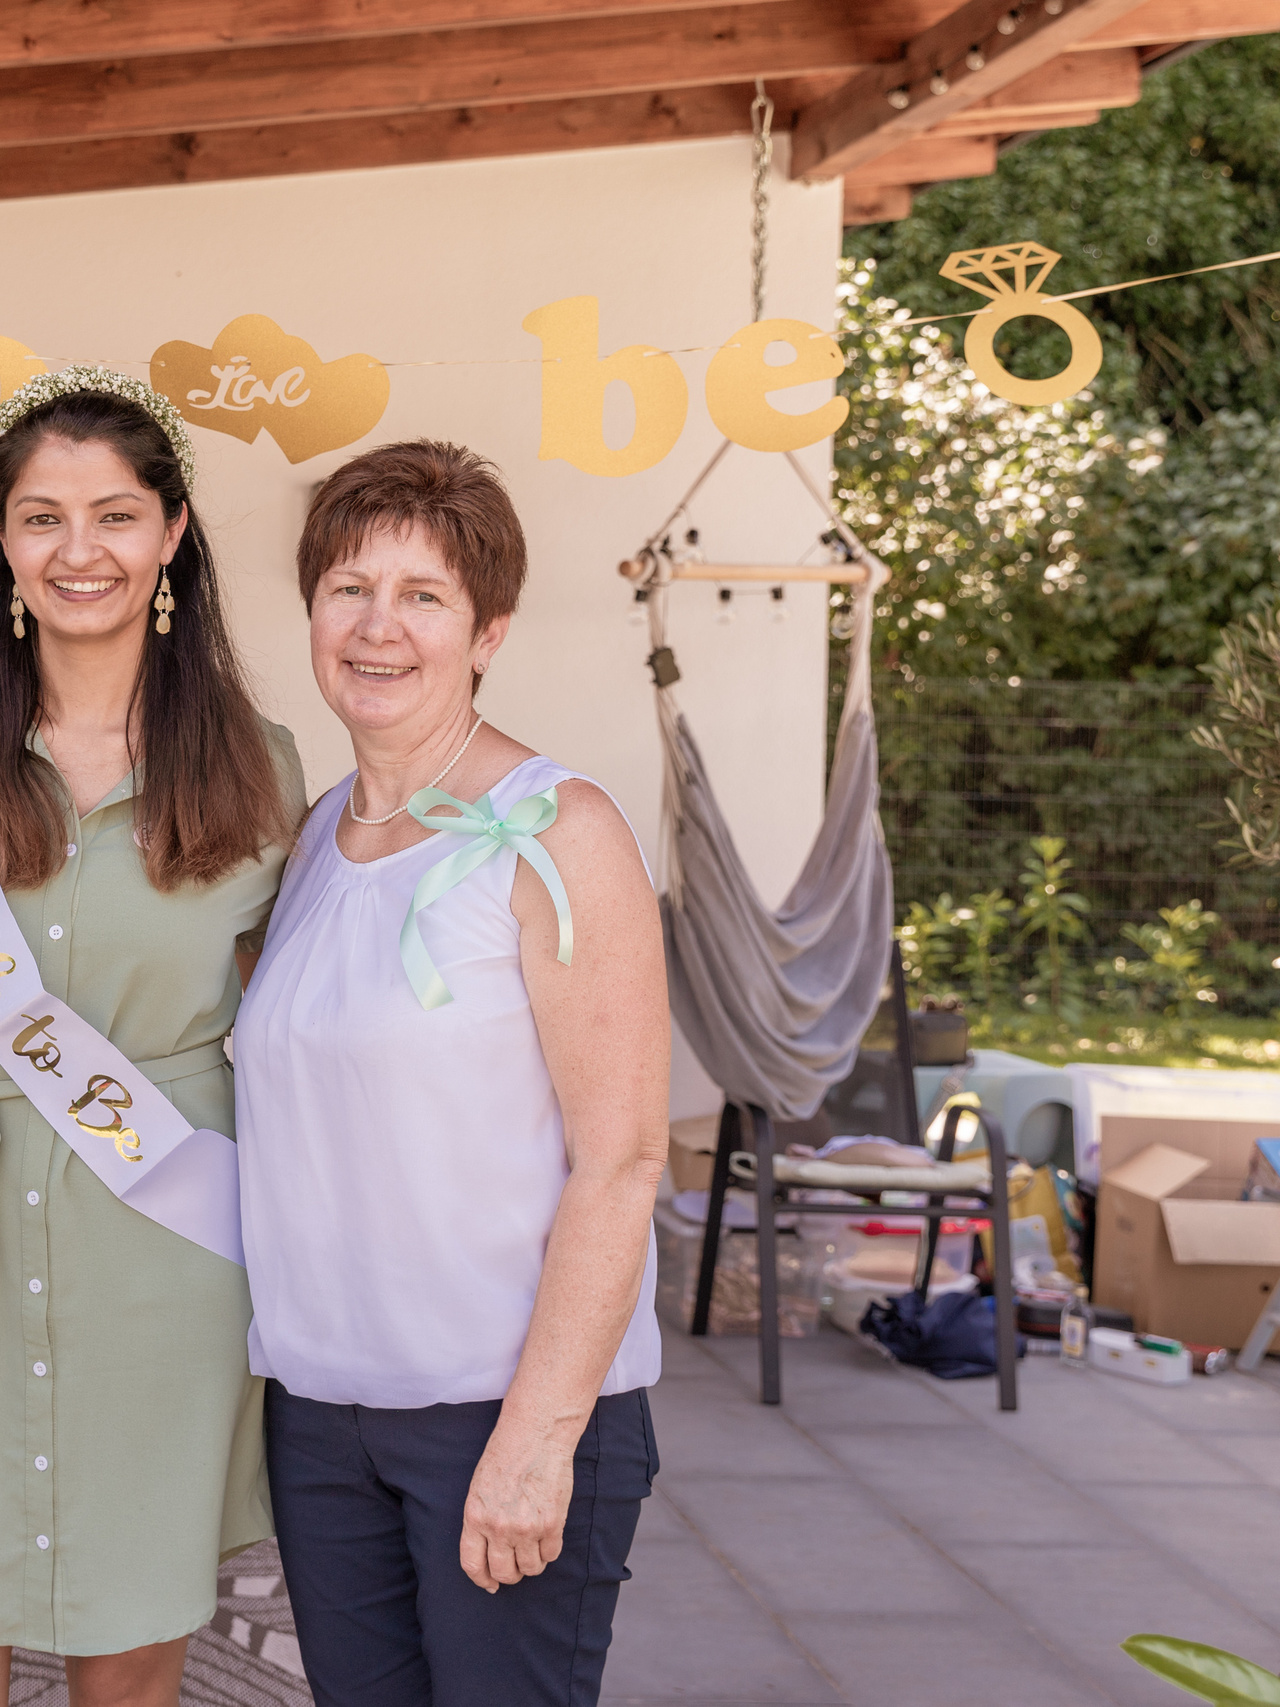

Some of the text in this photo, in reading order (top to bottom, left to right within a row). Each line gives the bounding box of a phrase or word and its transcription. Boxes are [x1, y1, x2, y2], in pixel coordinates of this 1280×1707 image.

[186, 355, 311, 411] Love
[522, 295, 850, 477] be
[12, 1014, 63, 1078] to
[67, 1074, 143, 1162] Be
